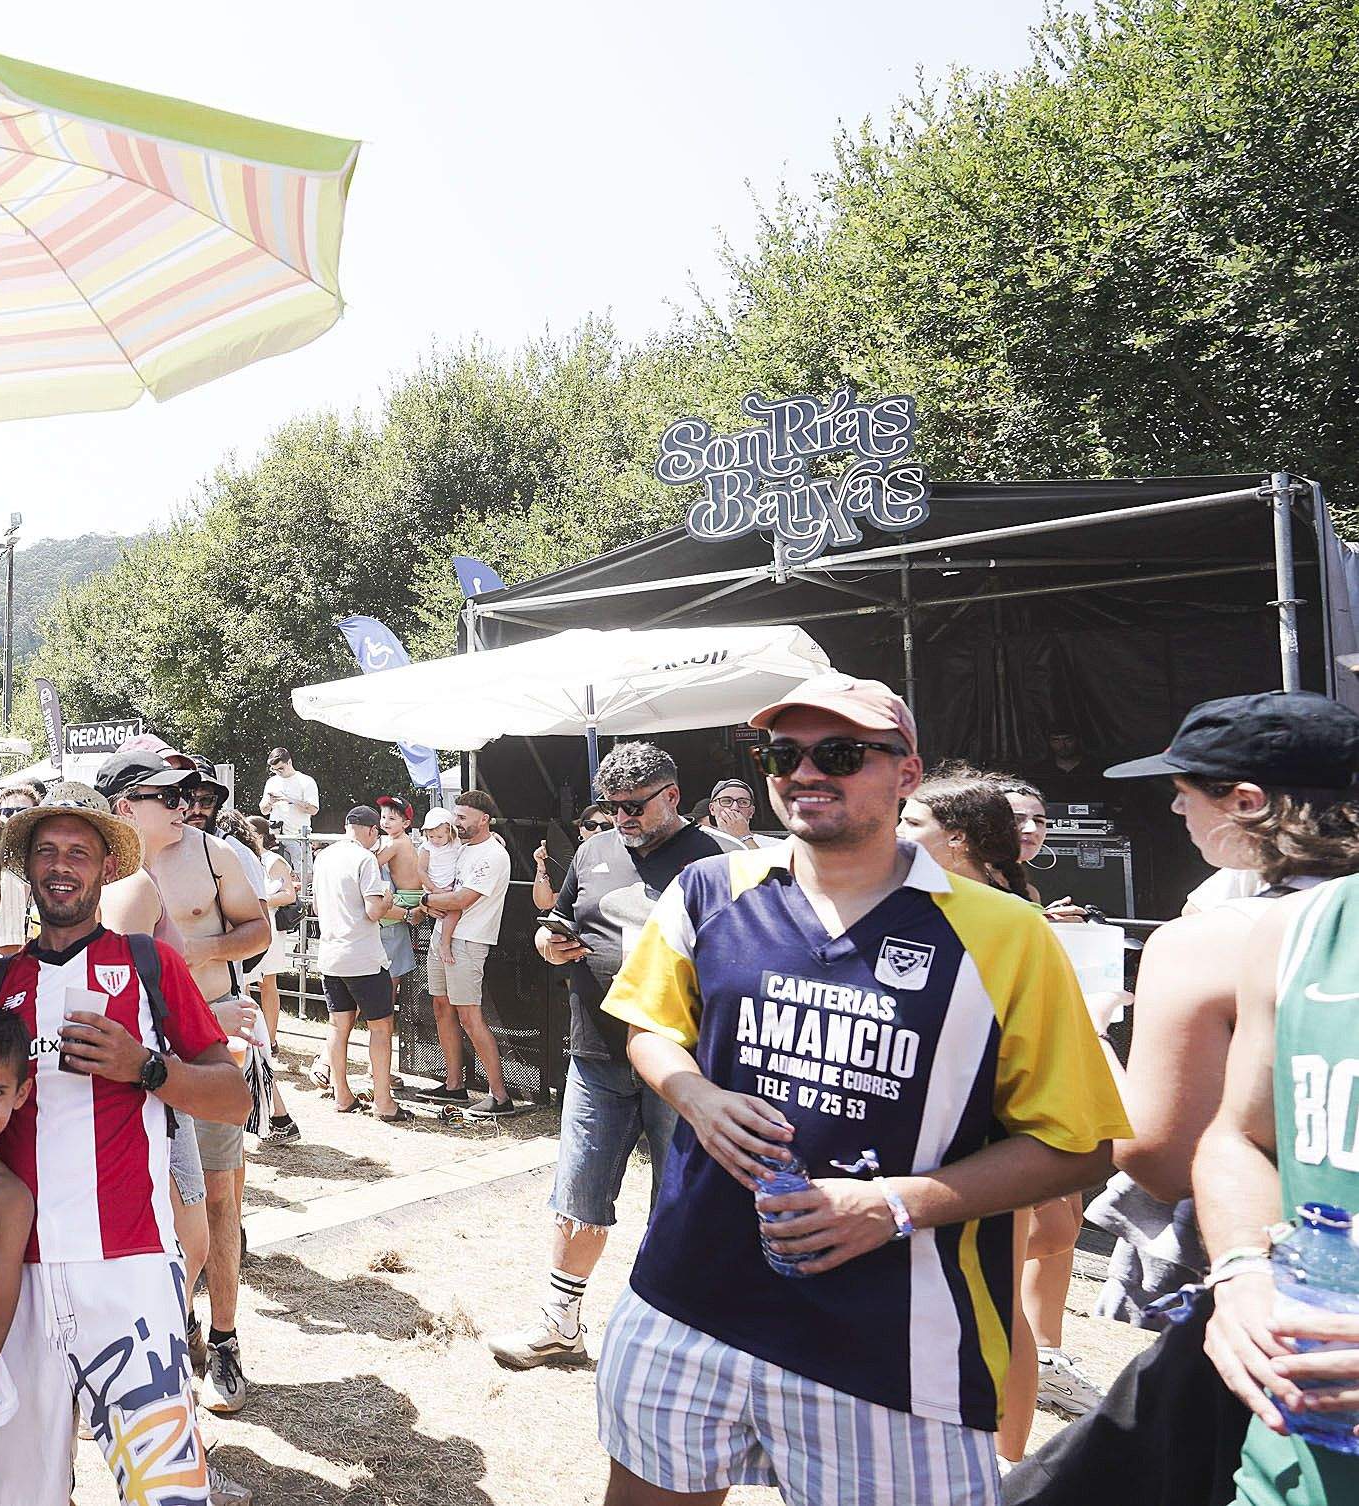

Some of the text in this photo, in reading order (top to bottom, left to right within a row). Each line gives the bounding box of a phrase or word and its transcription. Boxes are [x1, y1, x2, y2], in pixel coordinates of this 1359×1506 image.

[688, 459, 926, 562] Baixas
[766, 974, 897, 1022] CANTERIAS
[736, 996, 921, 1079] AMANCIO
[755, 1074, 791, 1102] TELE
[819, 1091, 843, 1116] 25
[845, 1098, 867, 1120] 53
[842, 1070, 901, 1101] COBRES
